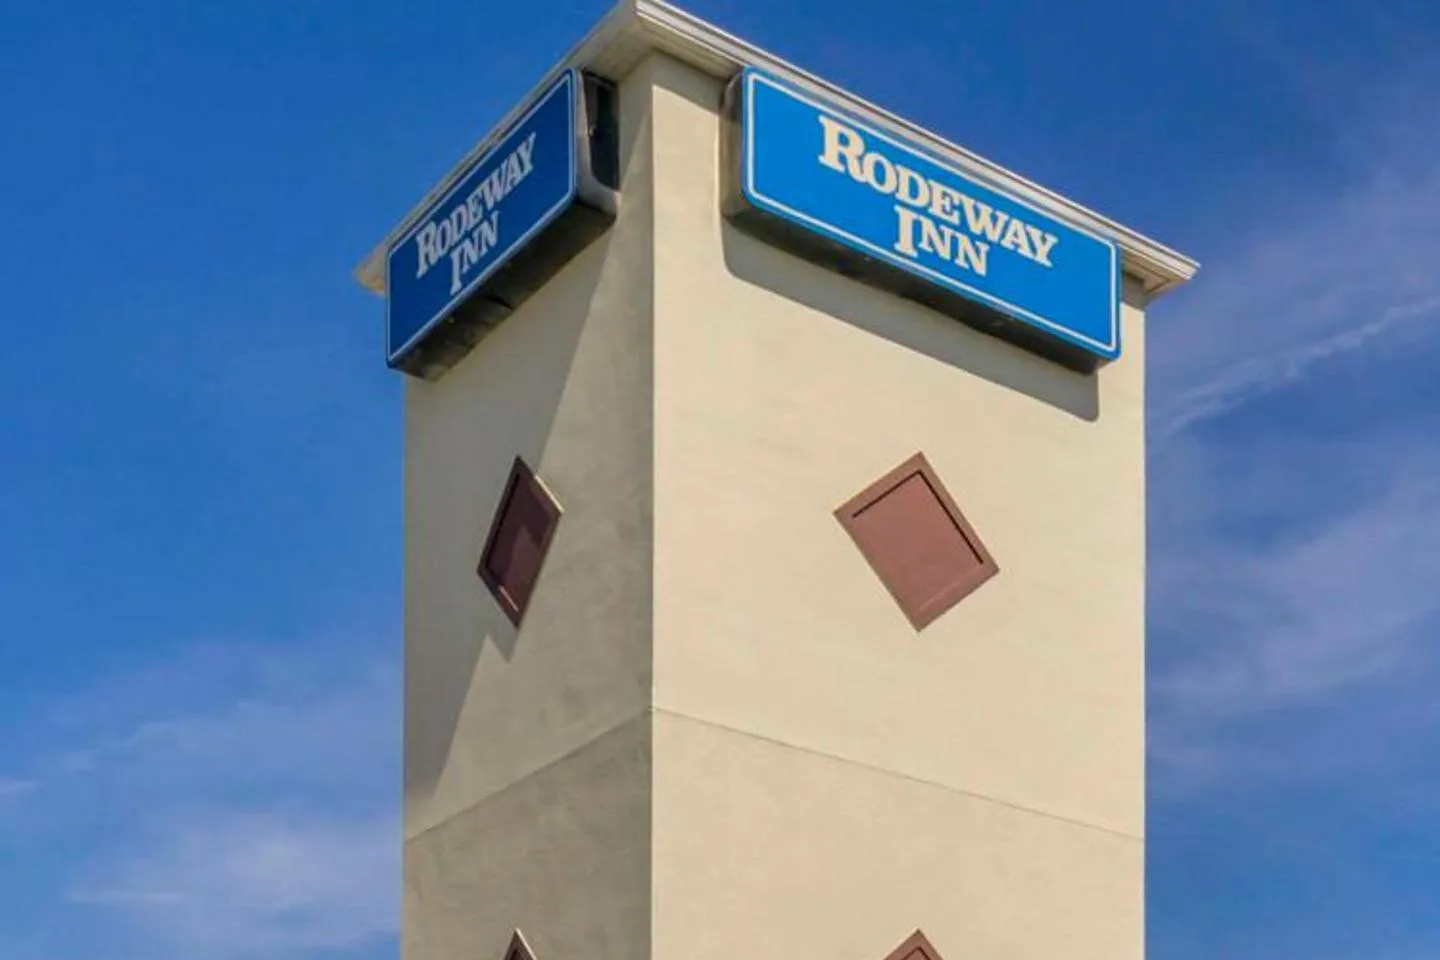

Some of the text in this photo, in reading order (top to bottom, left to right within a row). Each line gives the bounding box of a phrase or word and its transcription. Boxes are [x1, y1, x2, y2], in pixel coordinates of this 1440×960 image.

[415, 132, 537, 279] RODEWAY
[818, 114, 1059, 267] RODEWAY
[894, 205, 990, 277] INN
[450, 211, 500, 295] INN
